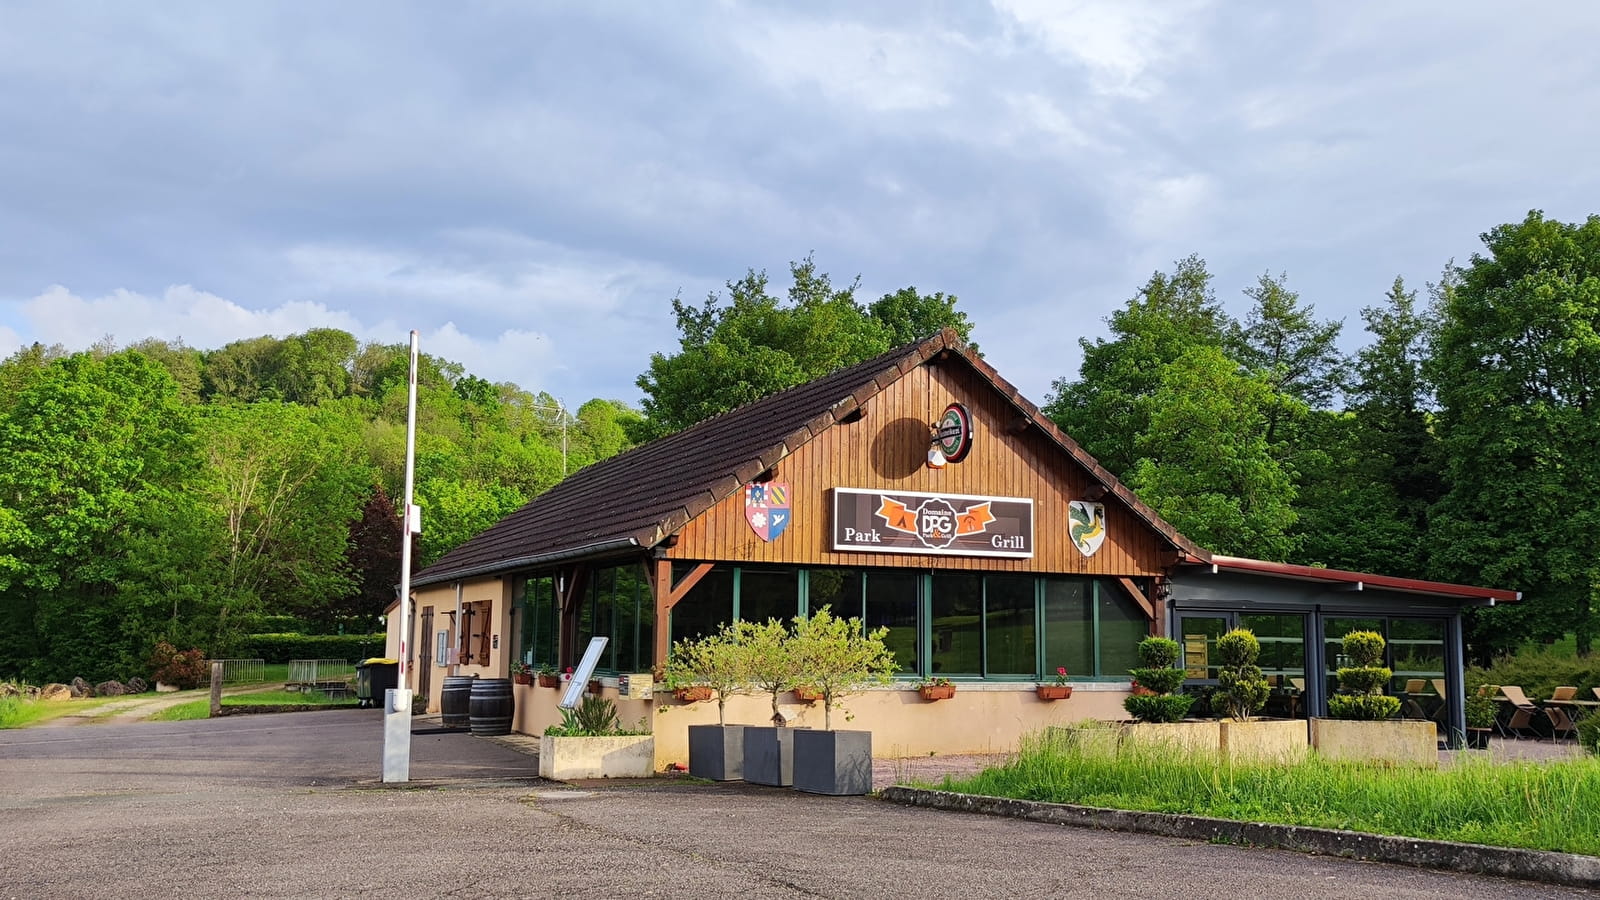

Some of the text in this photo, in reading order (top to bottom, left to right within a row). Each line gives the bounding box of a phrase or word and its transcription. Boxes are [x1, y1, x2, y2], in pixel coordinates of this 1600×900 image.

[922, 508, 951, 516] Domaine
[922, 515, 951, 533] DPG
[844, 527, 881, 542] Park
[933, 529, 941, 539] &
[991, 534, 1024, 549] Grill
